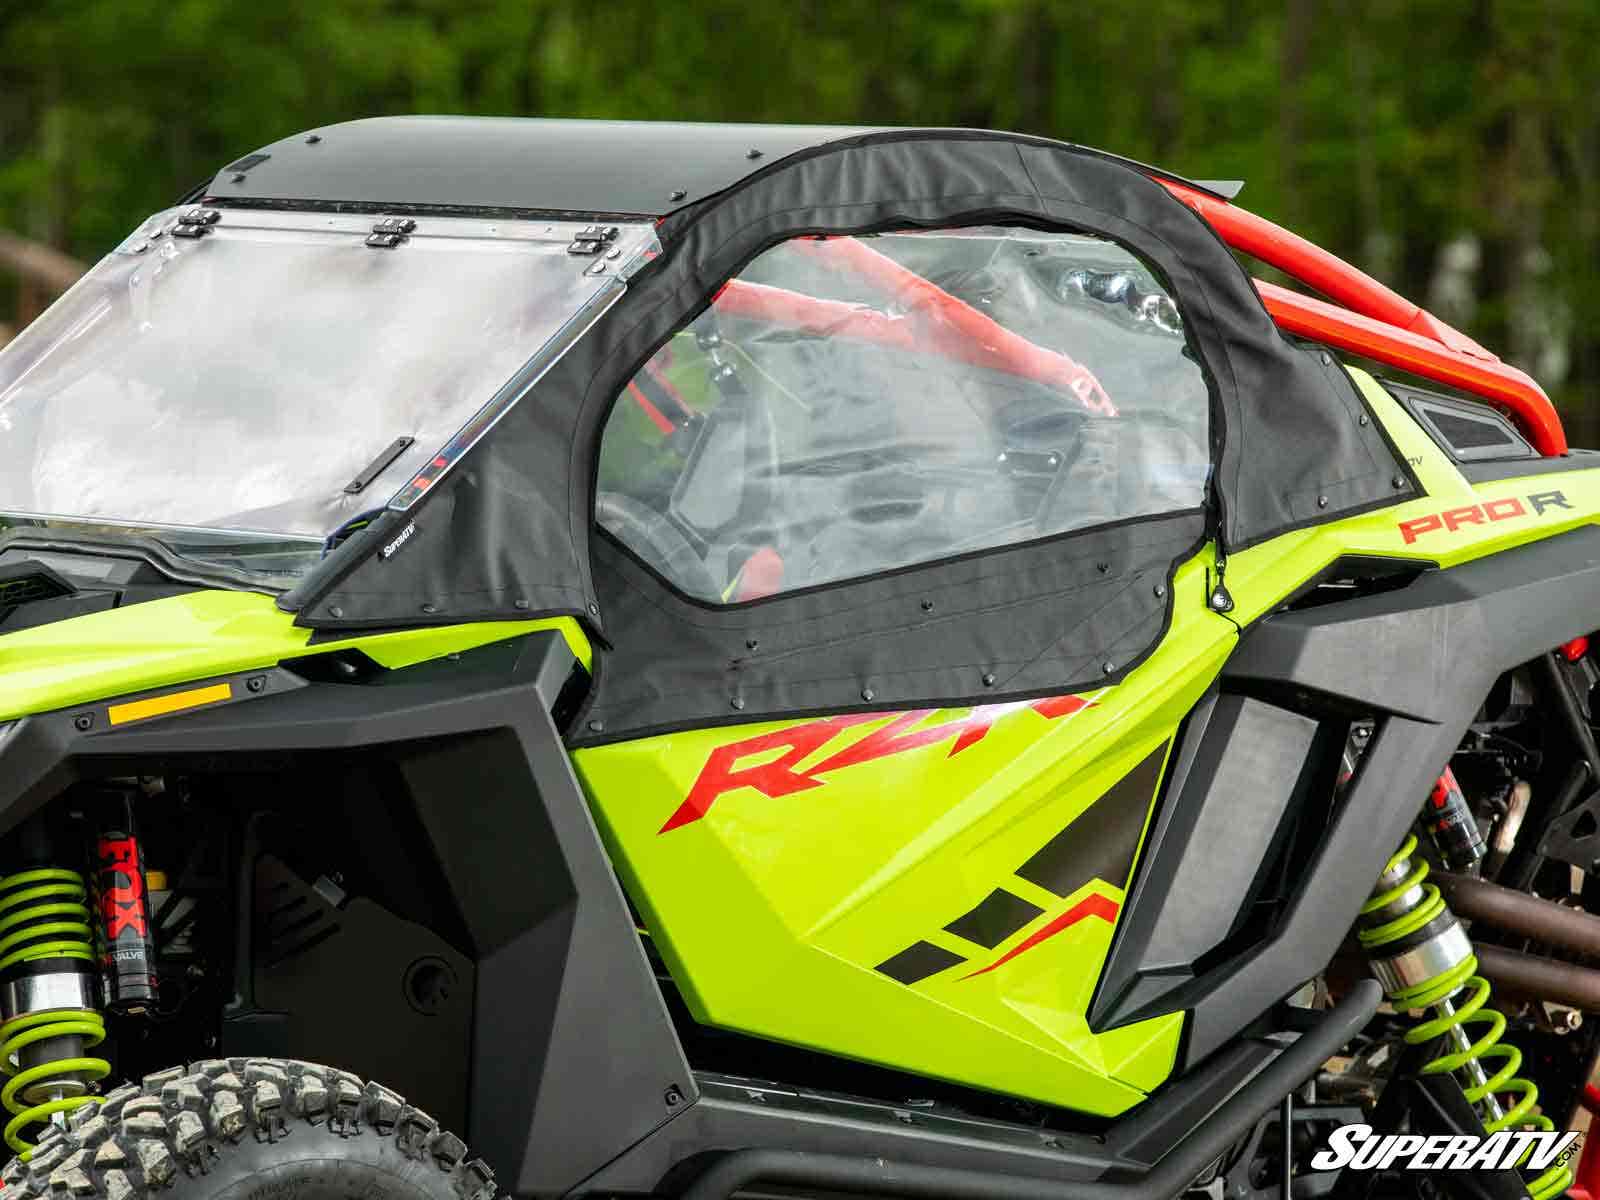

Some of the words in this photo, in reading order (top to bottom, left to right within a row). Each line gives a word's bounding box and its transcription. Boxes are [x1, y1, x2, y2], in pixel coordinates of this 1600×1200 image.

[1398, 497, 1527, 545] PRO
[1528, 490, 1575, 516] R
[99, 836, 147, 940] FOX
